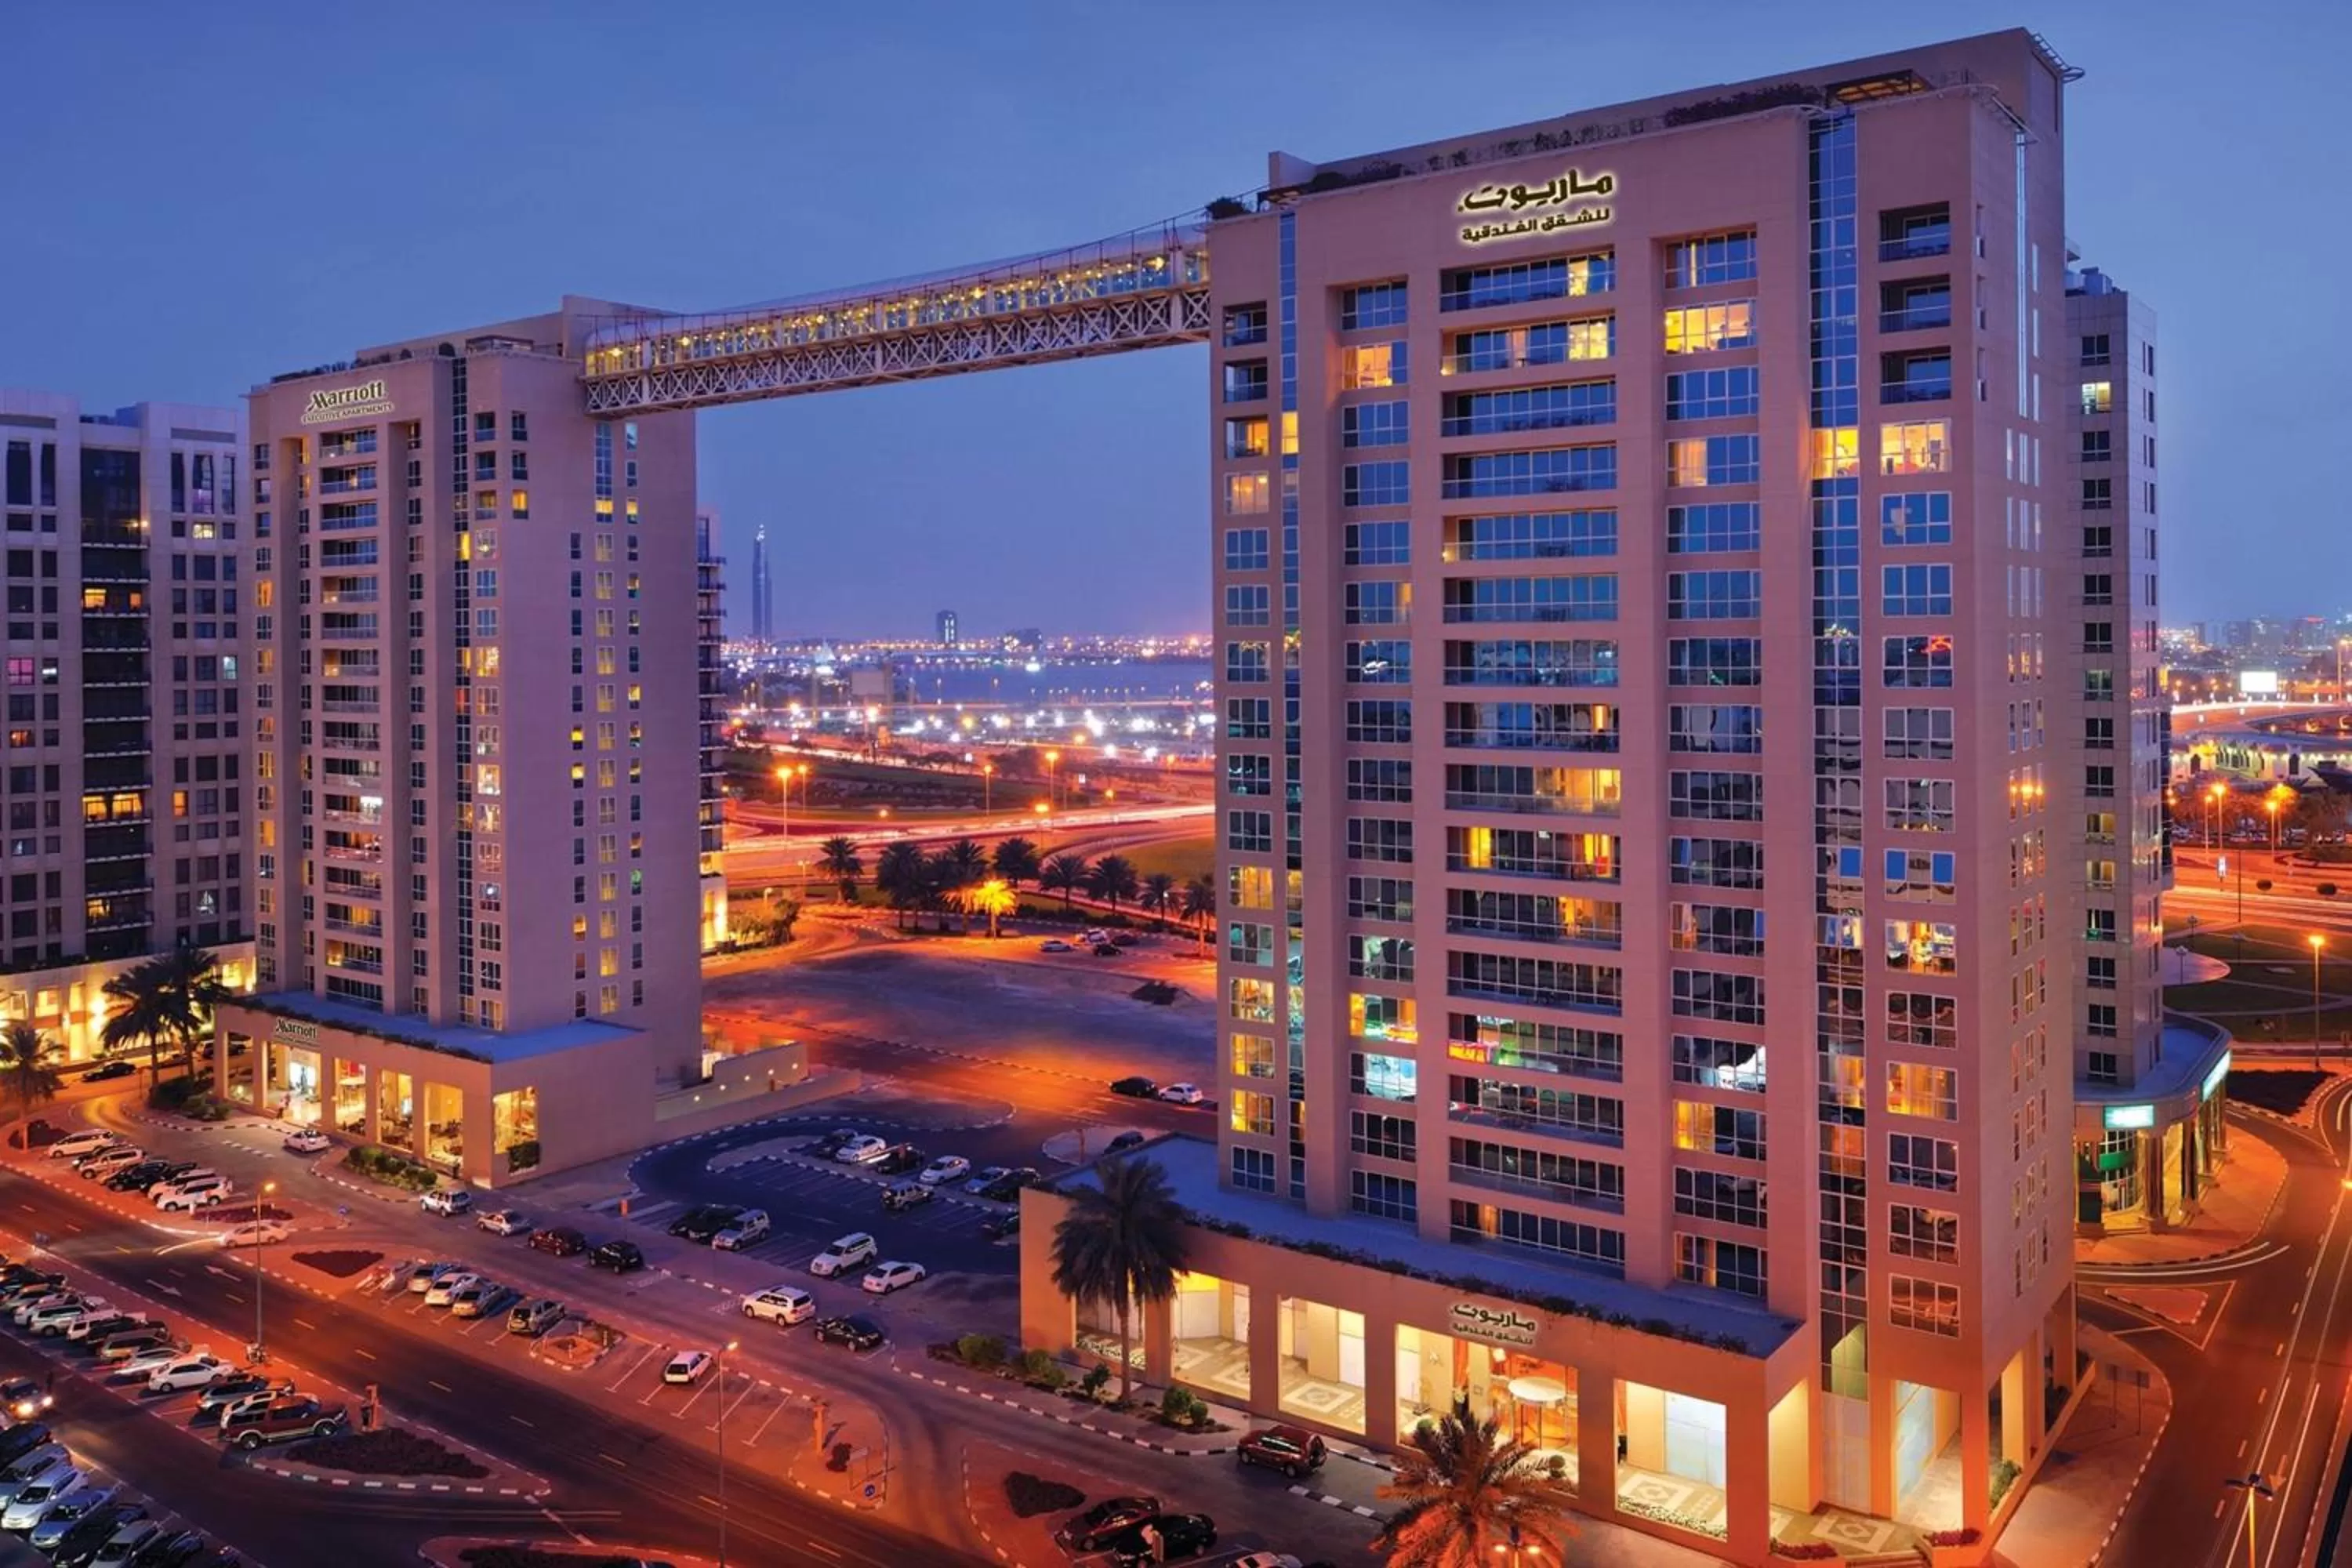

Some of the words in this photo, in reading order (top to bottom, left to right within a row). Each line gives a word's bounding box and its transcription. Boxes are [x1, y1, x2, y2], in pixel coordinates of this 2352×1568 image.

[1461, 219, 1538, 242] الفندقية
[1541, 207, 1610, 232] للشقق
[307, 381, 383, 412] Marriott
[275, 1018, 318, 1039] Marriott
